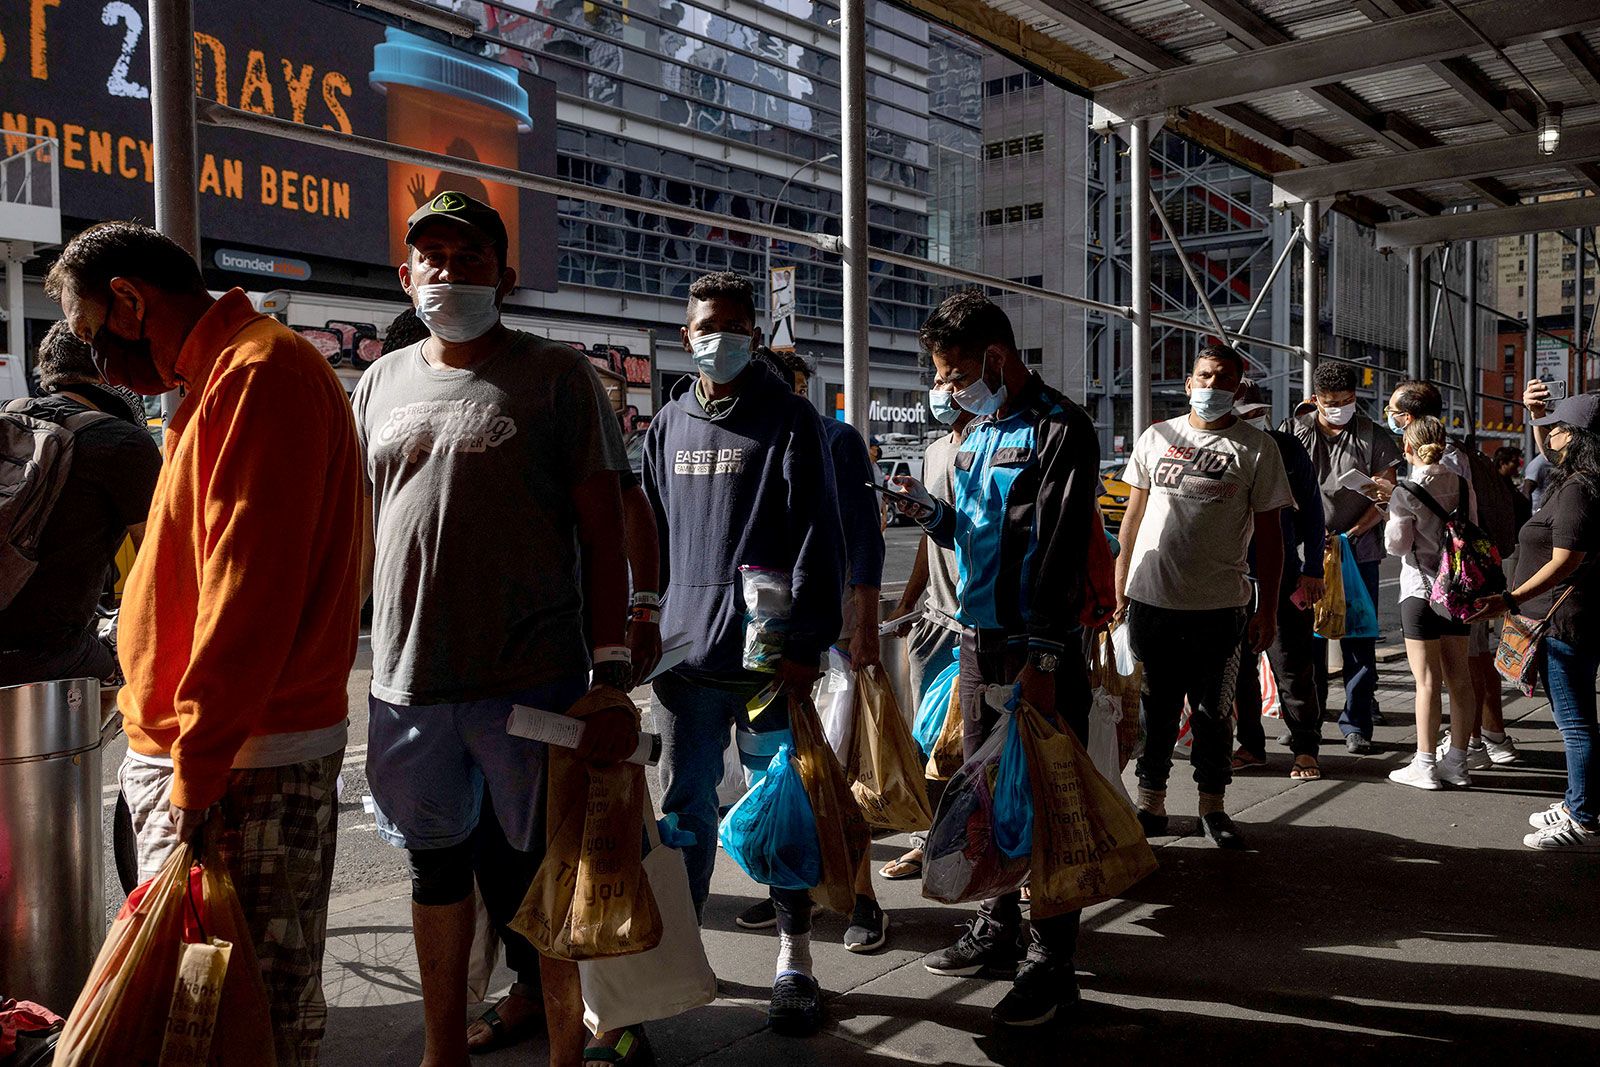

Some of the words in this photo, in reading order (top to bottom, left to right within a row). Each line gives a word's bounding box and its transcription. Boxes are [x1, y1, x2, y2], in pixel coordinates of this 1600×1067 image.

[0, 0, 60, 80] T
[101, 1, 149, 99] 2
[194, 31, 352, 134] DAYS
[199, 153, 243, 199] AN
[260, 166, 350, 219] BEGIN
[1155, 462, 1185, 485] FR
